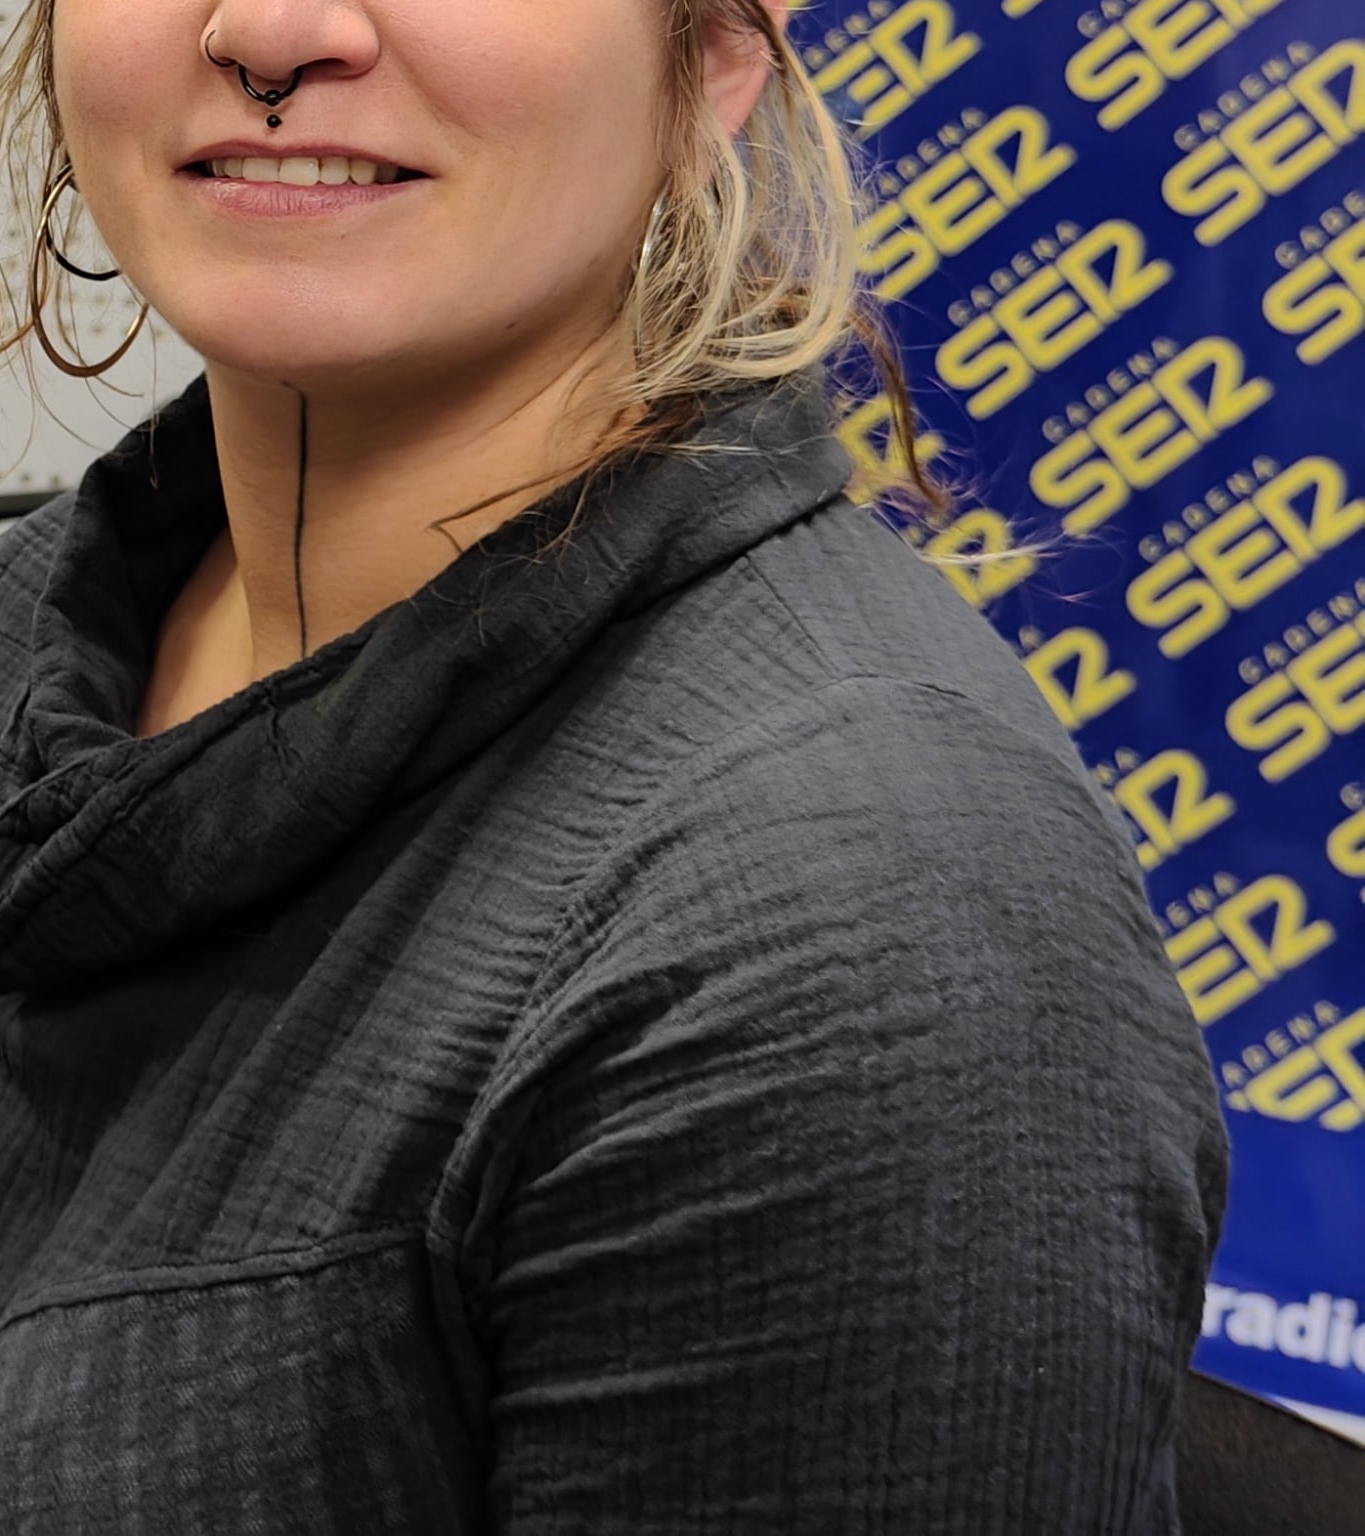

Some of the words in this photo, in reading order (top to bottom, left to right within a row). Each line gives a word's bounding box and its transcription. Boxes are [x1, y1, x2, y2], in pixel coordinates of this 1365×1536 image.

[854, 105, 1077, 305] SER
[935, 218, 1175, 421] SER
[1029, 335, 1275, 537] SER
[1126, 455, 1365, 660] SER
[1225, 607, 1365, 786] SE
[1200, 1281, 1365, 1375] radi
